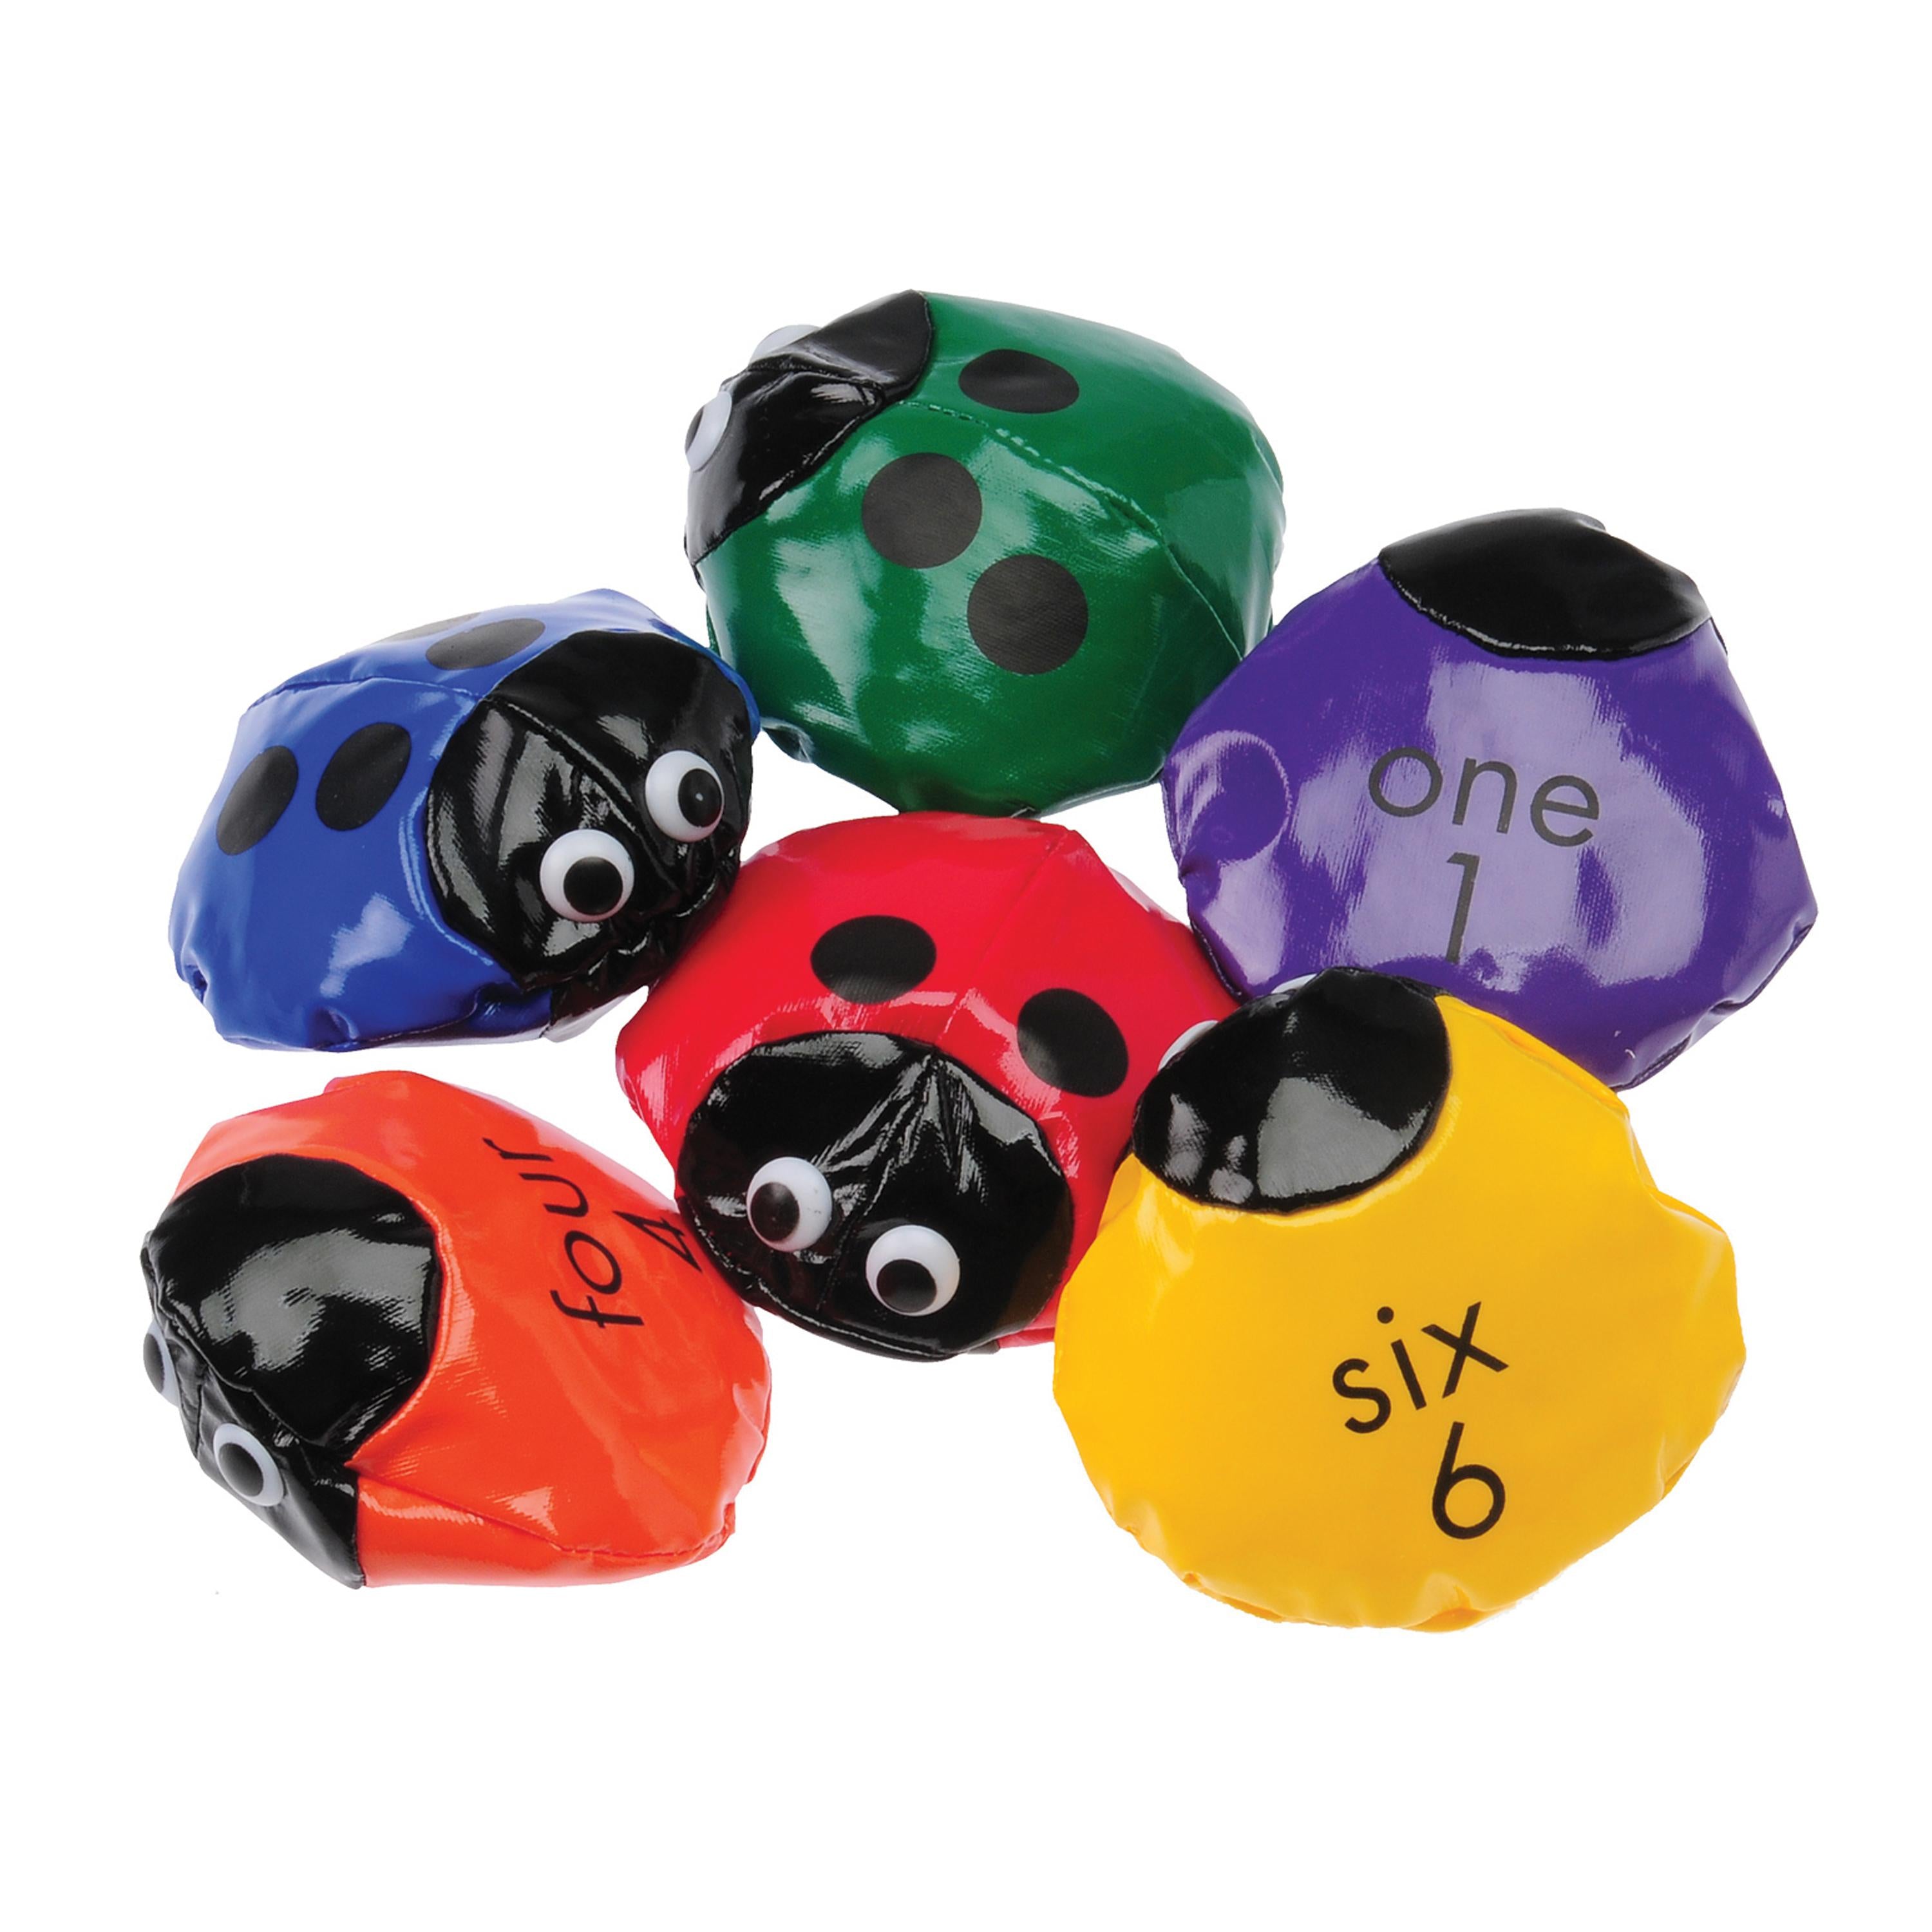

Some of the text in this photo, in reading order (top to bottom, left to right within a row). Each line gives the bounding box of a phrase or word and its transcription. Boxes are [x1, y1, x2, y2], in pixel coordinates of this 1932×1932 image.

[1368, 746, 1600, 847] one
[1445, 851, 1481, 965] 1
[482, 1137, 645, 1329] four
[612, 1210, 703, 1273] 4
[1332, 1301, 1510, 1434] six
[1432, 1421, 1506, 1540] 6
